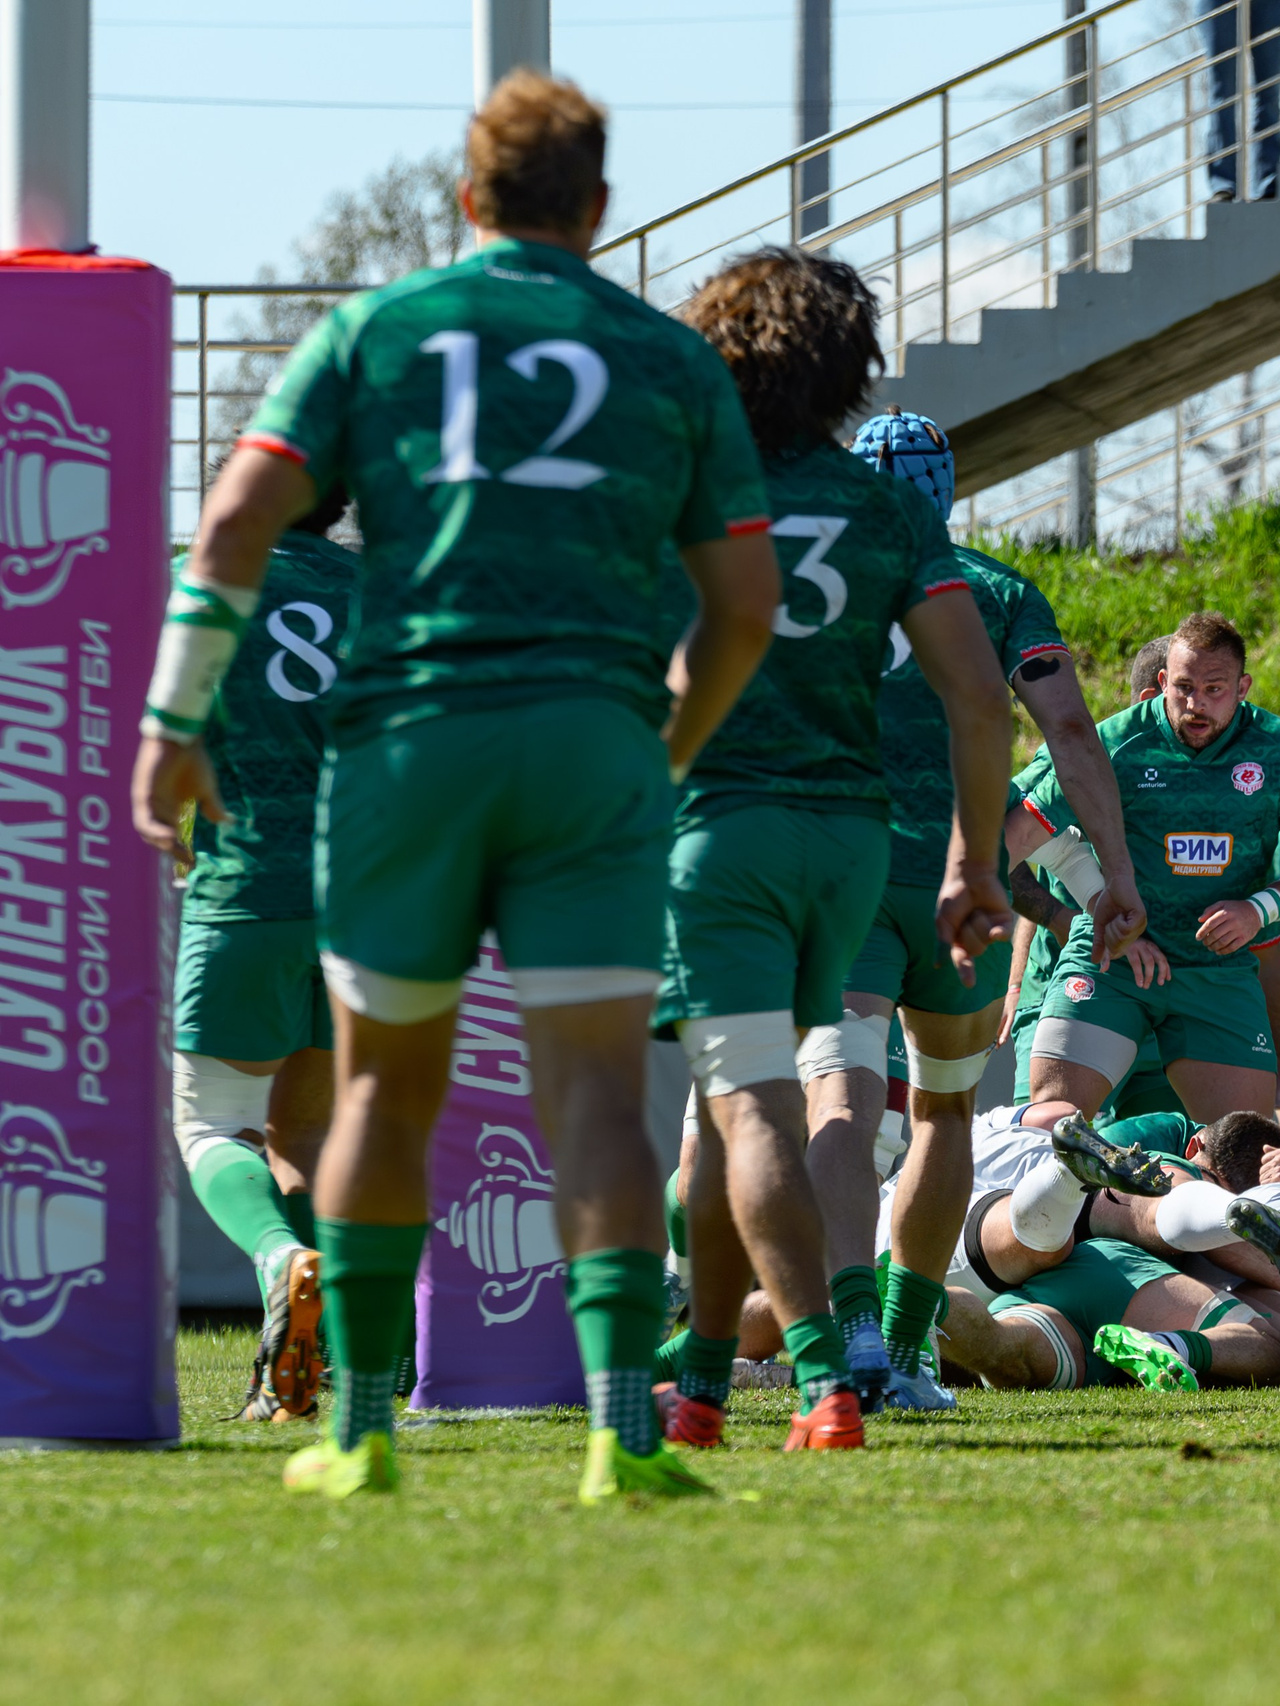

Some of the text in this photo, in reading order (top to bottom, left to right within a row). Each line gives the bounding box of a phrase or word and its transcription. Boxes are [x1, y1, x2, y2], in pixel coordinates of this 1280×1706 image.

[418, 329, 610, 491] 12
[767, 513, 850, 639] 3
[265, 600, 338, 703] 8
[1136, 781, 1168, 789] centurion
[77, 617, 112, 1106] РОССИИ ПО РЕГБИ
[1171, 838, 1227, 861] РИМ
[1173, 864, 1222, 875] МЕДИАГРУППА
